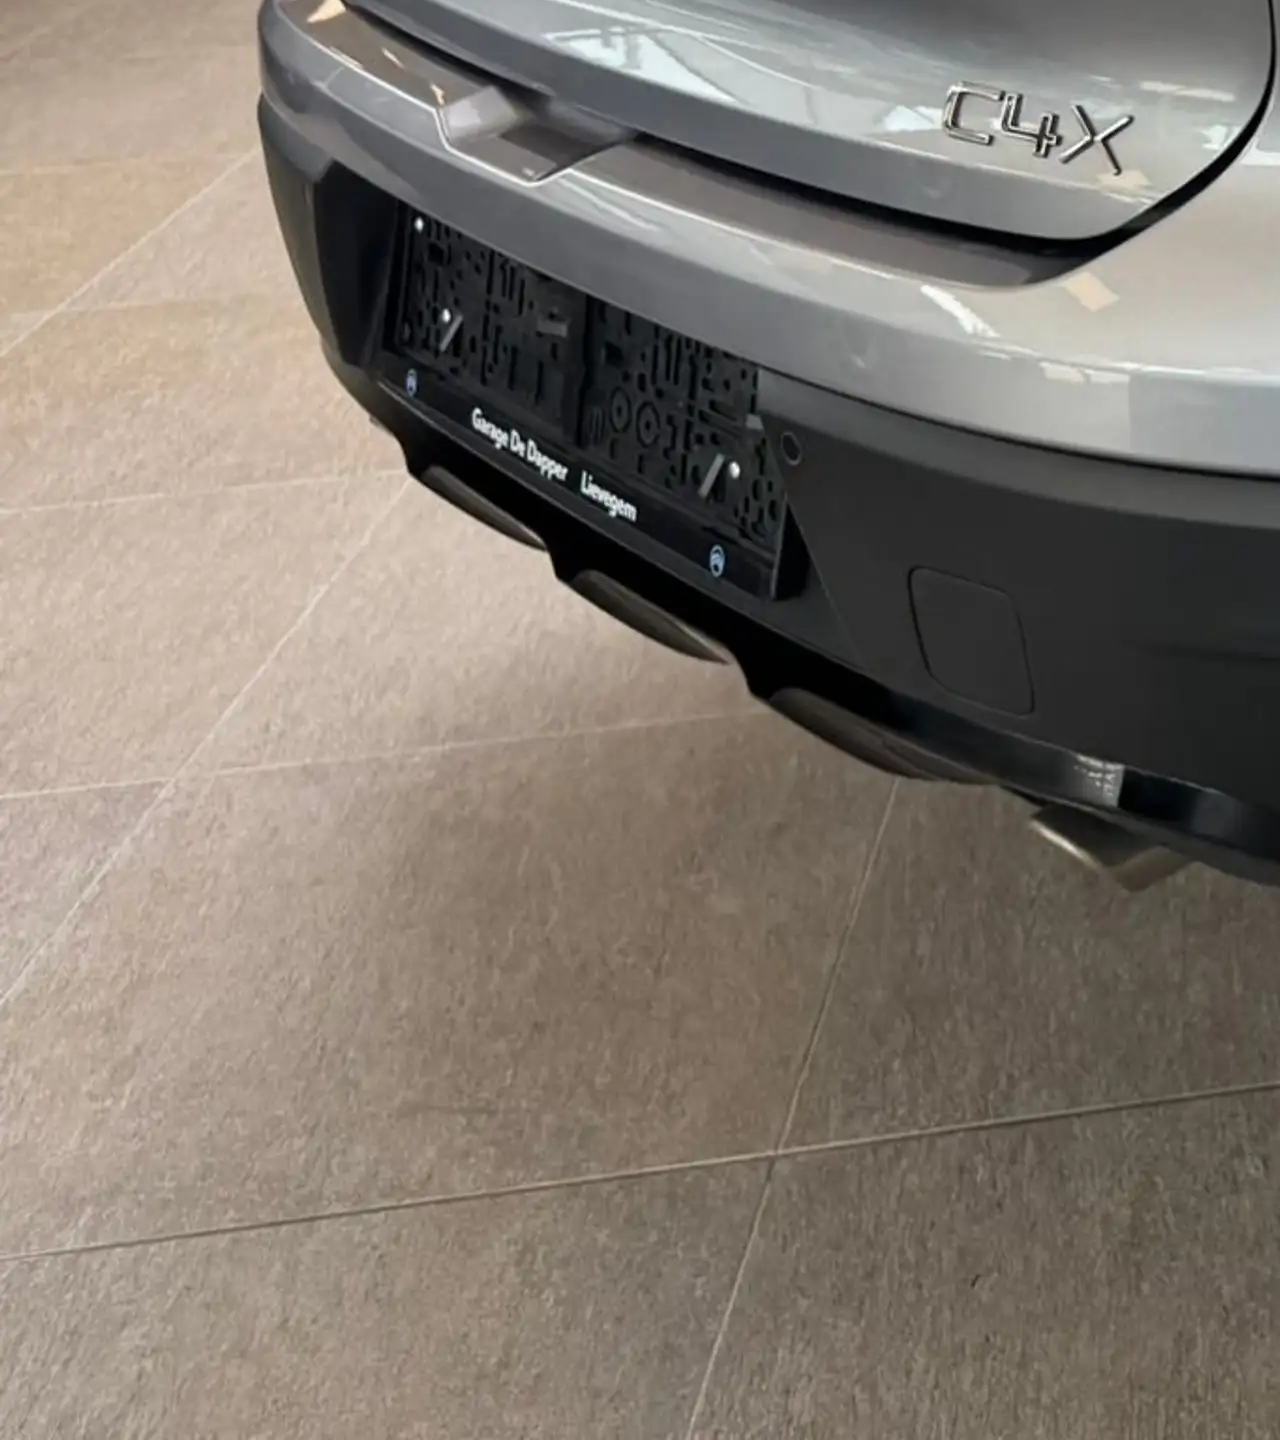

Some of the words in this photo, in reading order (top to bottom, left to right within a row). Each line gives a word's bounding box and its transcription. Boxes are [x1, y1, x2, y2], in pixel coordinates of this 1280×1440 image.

[471, 406, 508, 449] Garage
[510, 429, 526, 458] De
[527, 439, 568, 481] Dapper
[580, 471, 637, 521] Lievegem
